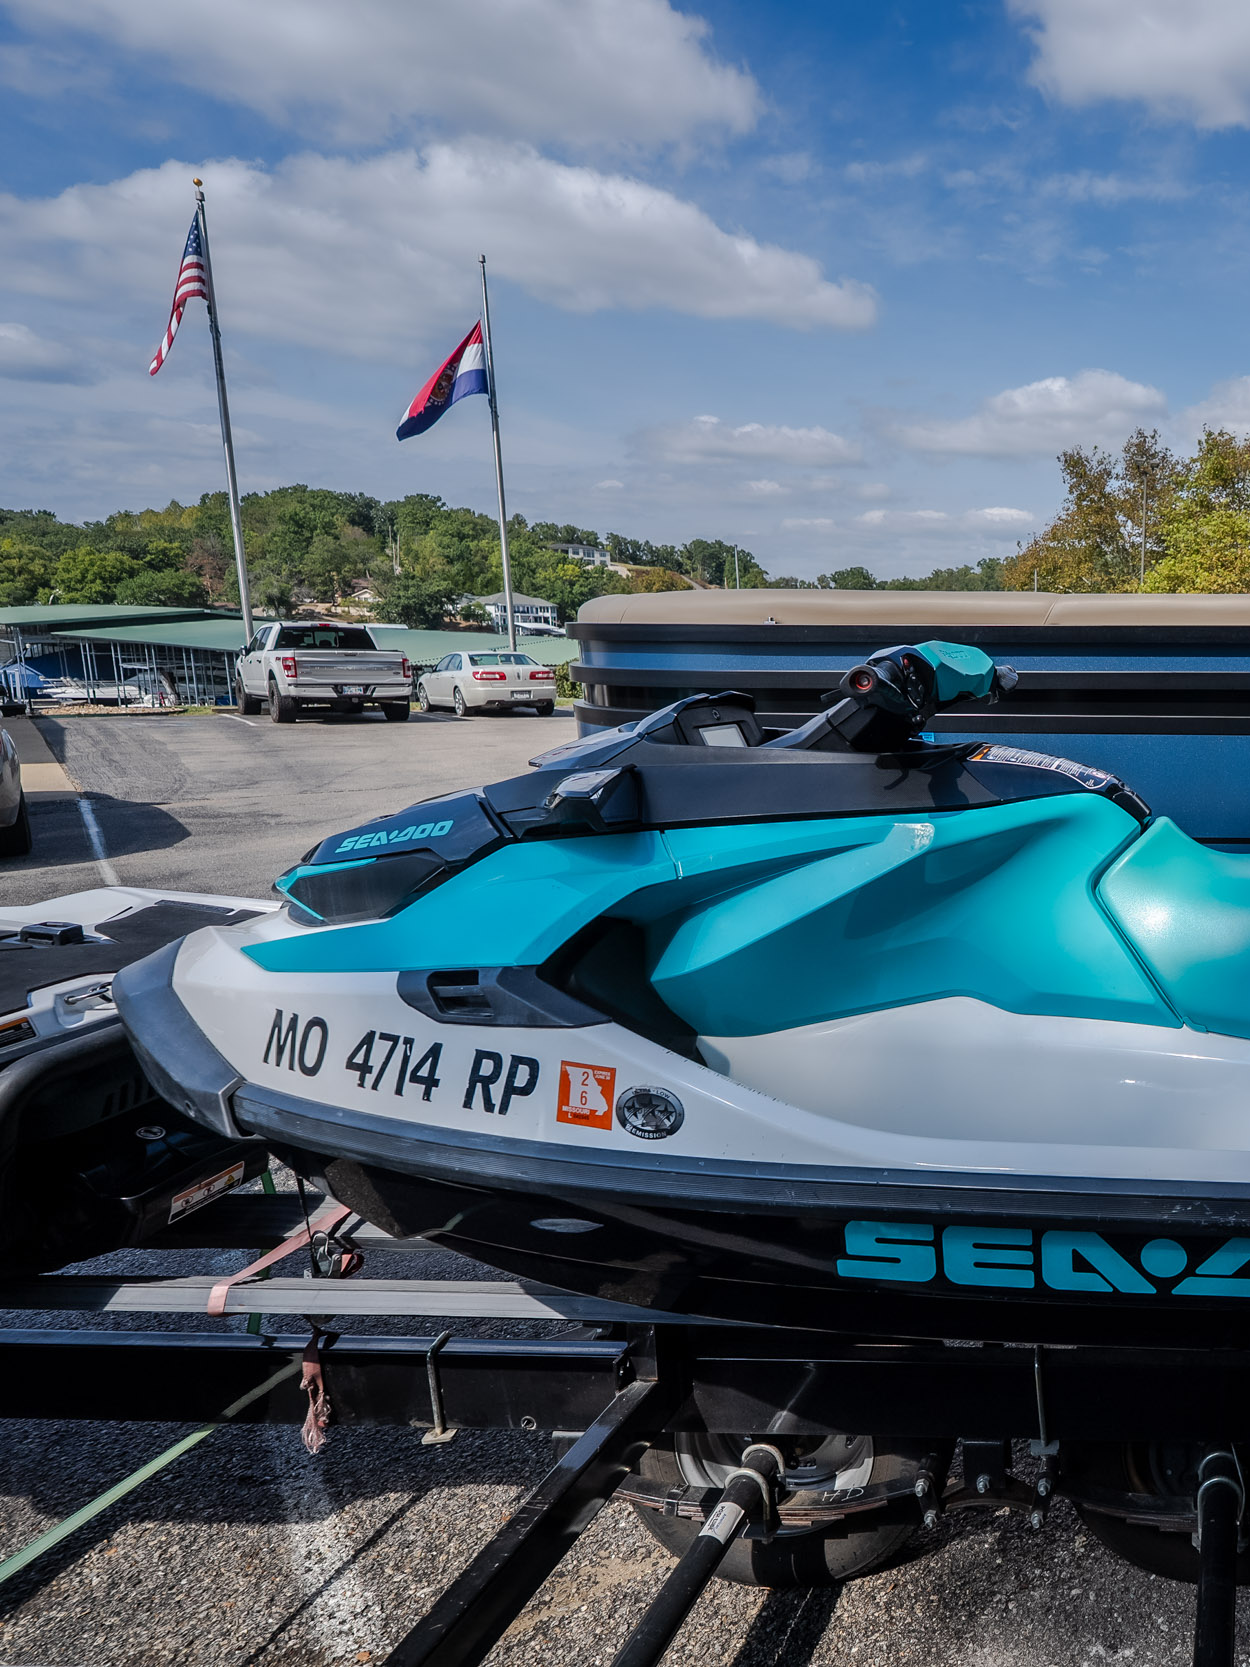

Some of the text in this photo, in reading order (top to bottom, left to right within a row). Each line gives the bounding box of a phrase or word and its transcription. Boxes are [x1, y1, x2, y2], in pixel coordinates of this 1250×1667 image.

[263, 1008, 540, 1116] MO 4714 RP
[581, 1071, 590, 1087] 2
[580, 1090, 588, 1106] 6
[562, 1105, 590, 1115] MISSOURI
[631, 1127, 667, 1139] EMISSION
